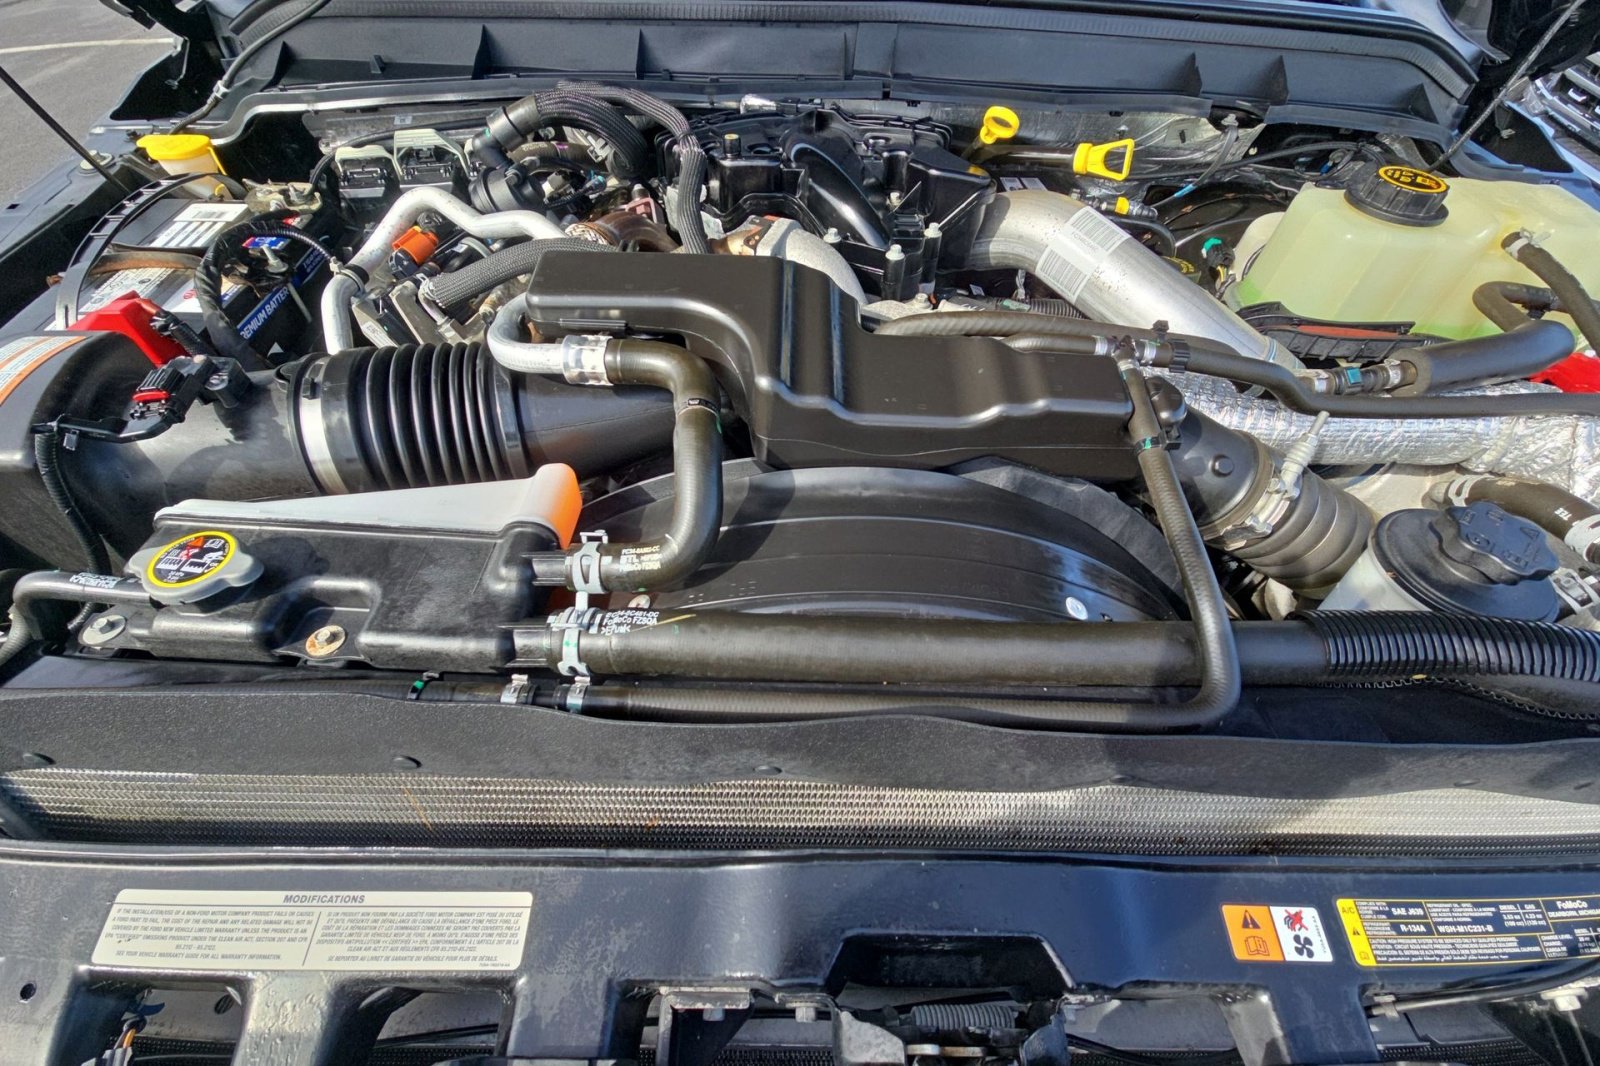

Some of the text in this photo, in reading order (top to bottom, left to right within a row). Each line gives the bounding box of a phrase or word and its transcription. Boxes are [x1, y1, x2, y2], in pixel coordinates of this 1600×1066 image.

[240, 310, 266, 340] REMIUM
[264, 286, 290, 315] BATTER
[283, 895, 365, 904] MODIFICATIONS
[1556, 900, 1588, 909] FoMoCo
[1400, 924, 1426, 932] R-134A
